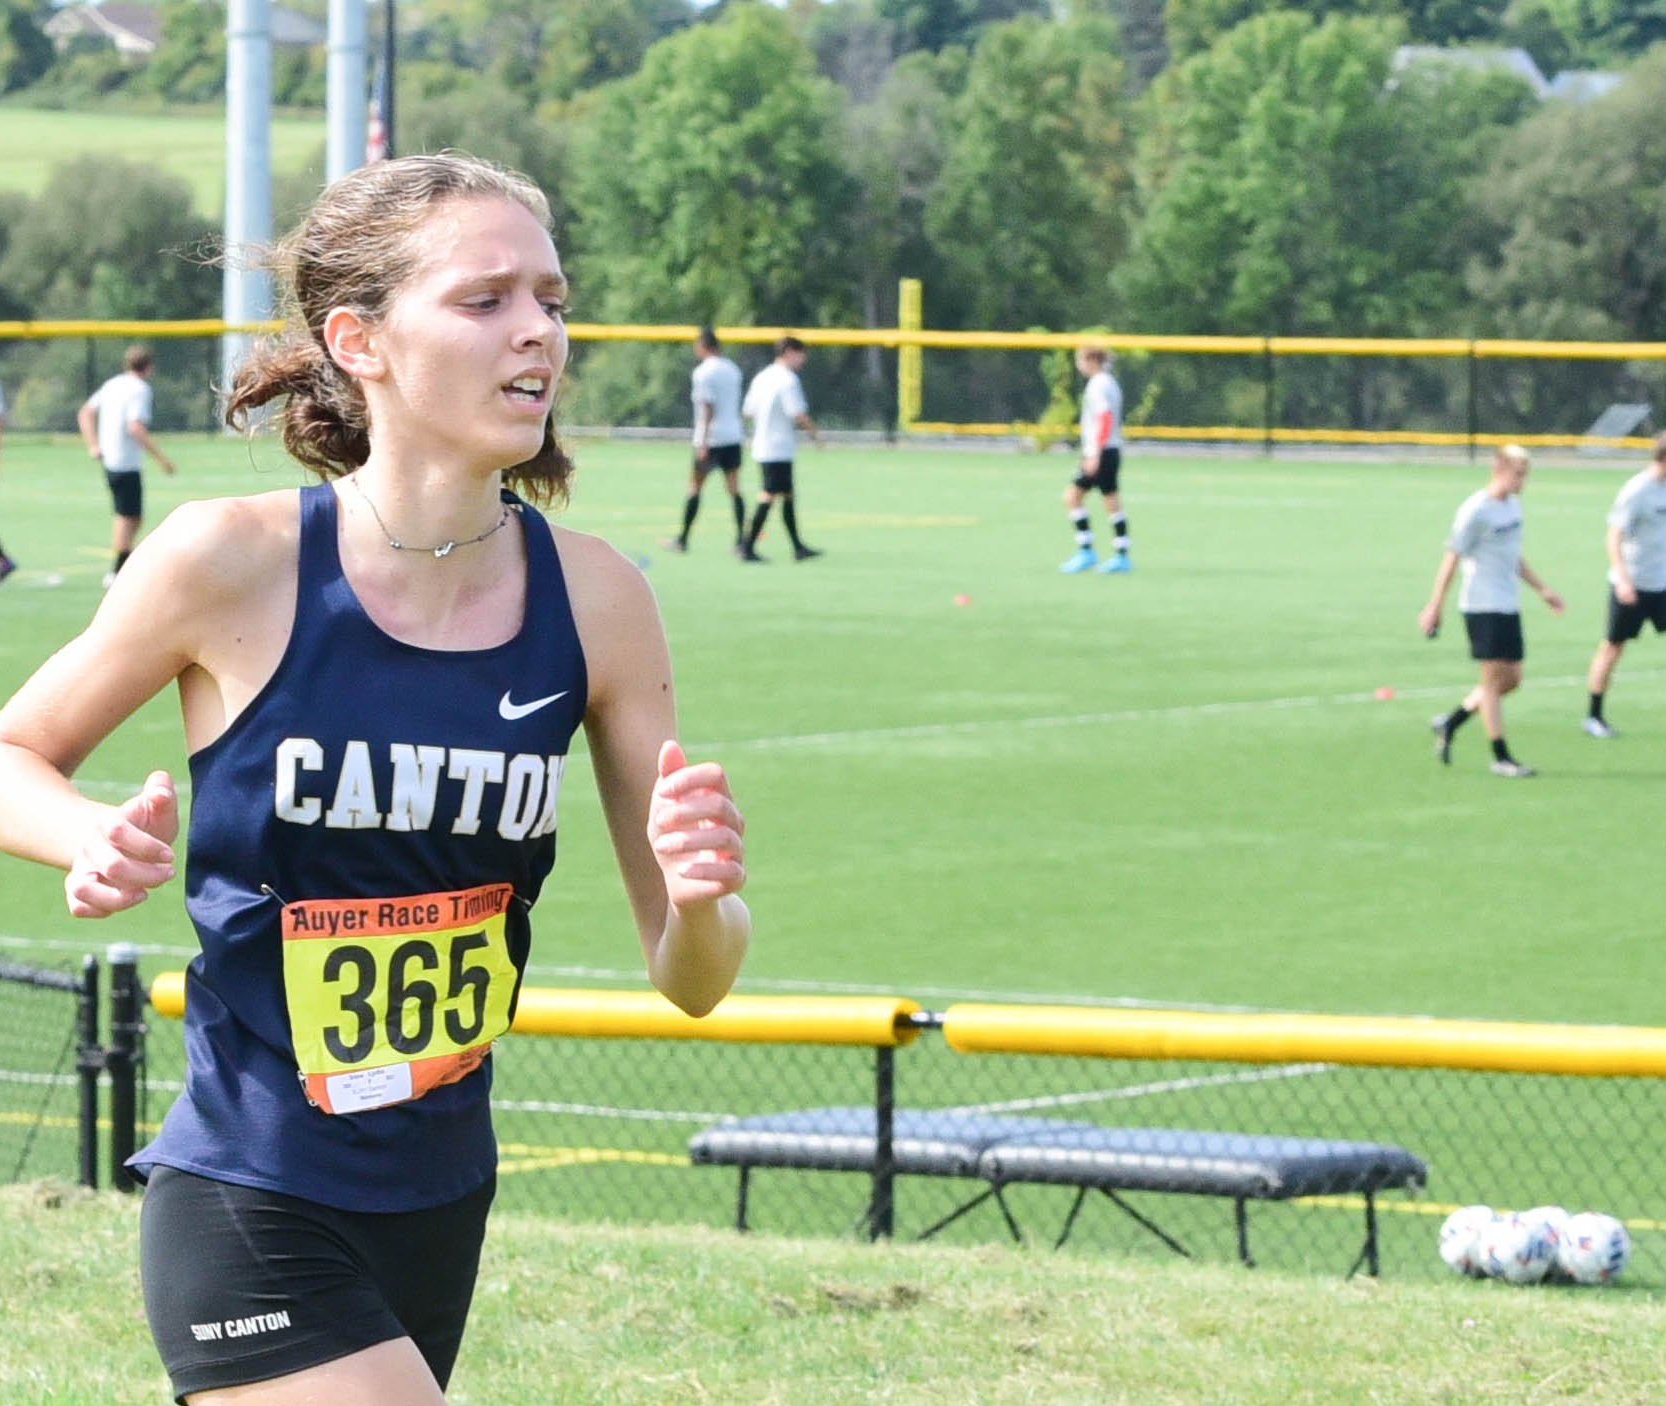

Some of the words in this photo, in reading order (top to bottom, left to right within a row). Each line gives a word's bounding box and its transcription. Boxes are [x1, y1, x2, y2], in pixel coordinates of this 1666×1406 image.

[292, 906, 368, 936] Auyer
[378, 903, 439, 928] Race
[323, 930, 490, 1063] 365
[225, 1310, 291, 1338] CANTON
